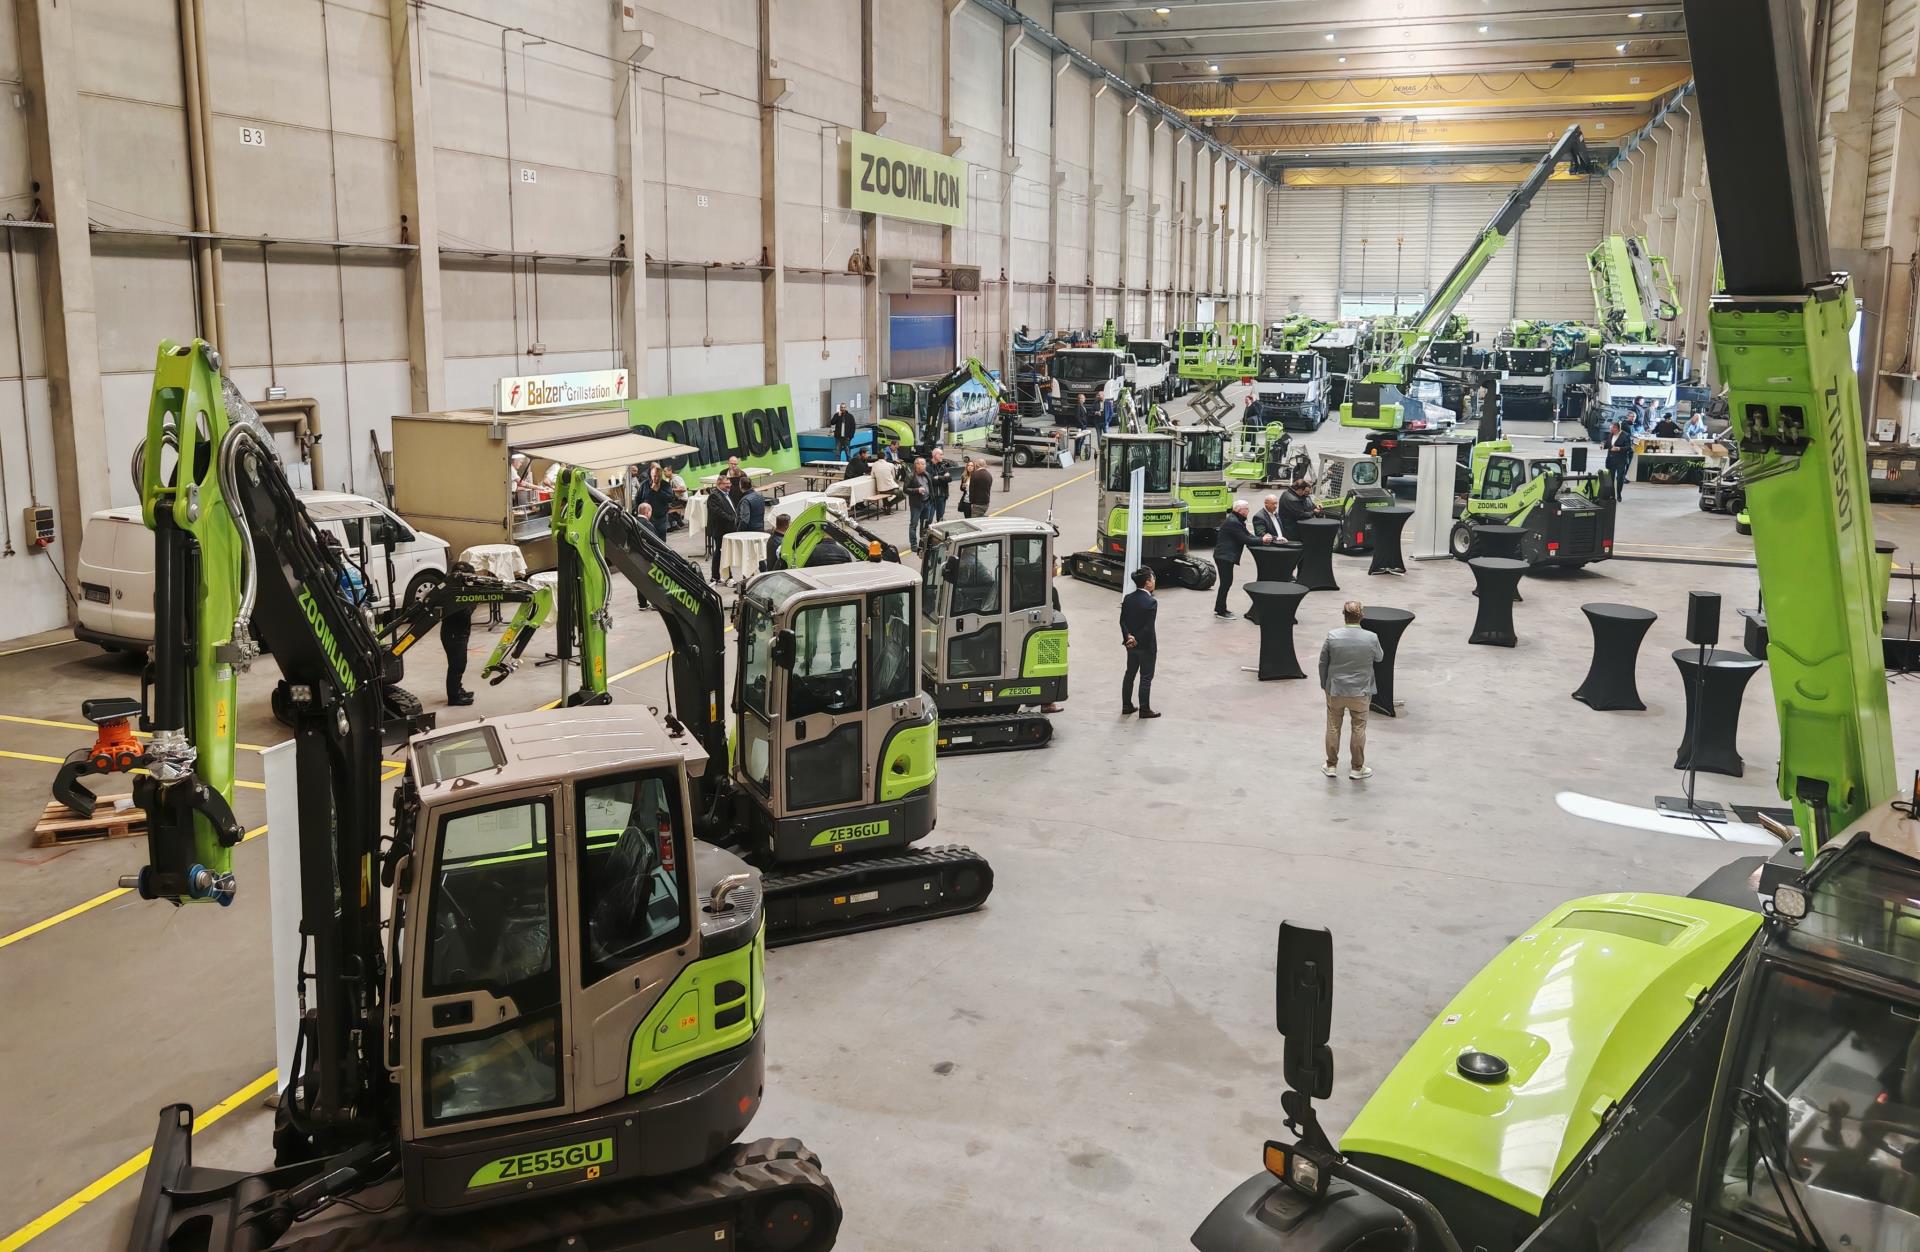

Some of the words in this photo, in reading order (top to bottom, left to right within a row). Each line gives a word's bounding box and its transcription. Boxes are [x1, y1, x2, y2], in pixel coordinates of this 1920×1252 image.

[860, 152, 960, 209] ZOOMLION
[566, 384, 610, 401] Grillstation
[632, 406, 793, 474] OMLION
[1477, 502, 1508, 510] ZOOMLION
[1142, 512, 1172, 521] OMLION
[455, 594, 504, 603] ZOOMLION
[647, 562, 701, 616] ZOOMLION
[298, 582, 357, 693] ZOOMLION
[1008, 687, 1032, 695] ZE20G
[829, 823, 881, 842] ZE36GU
[498, 1142, 603, 1179] ZE55GU
